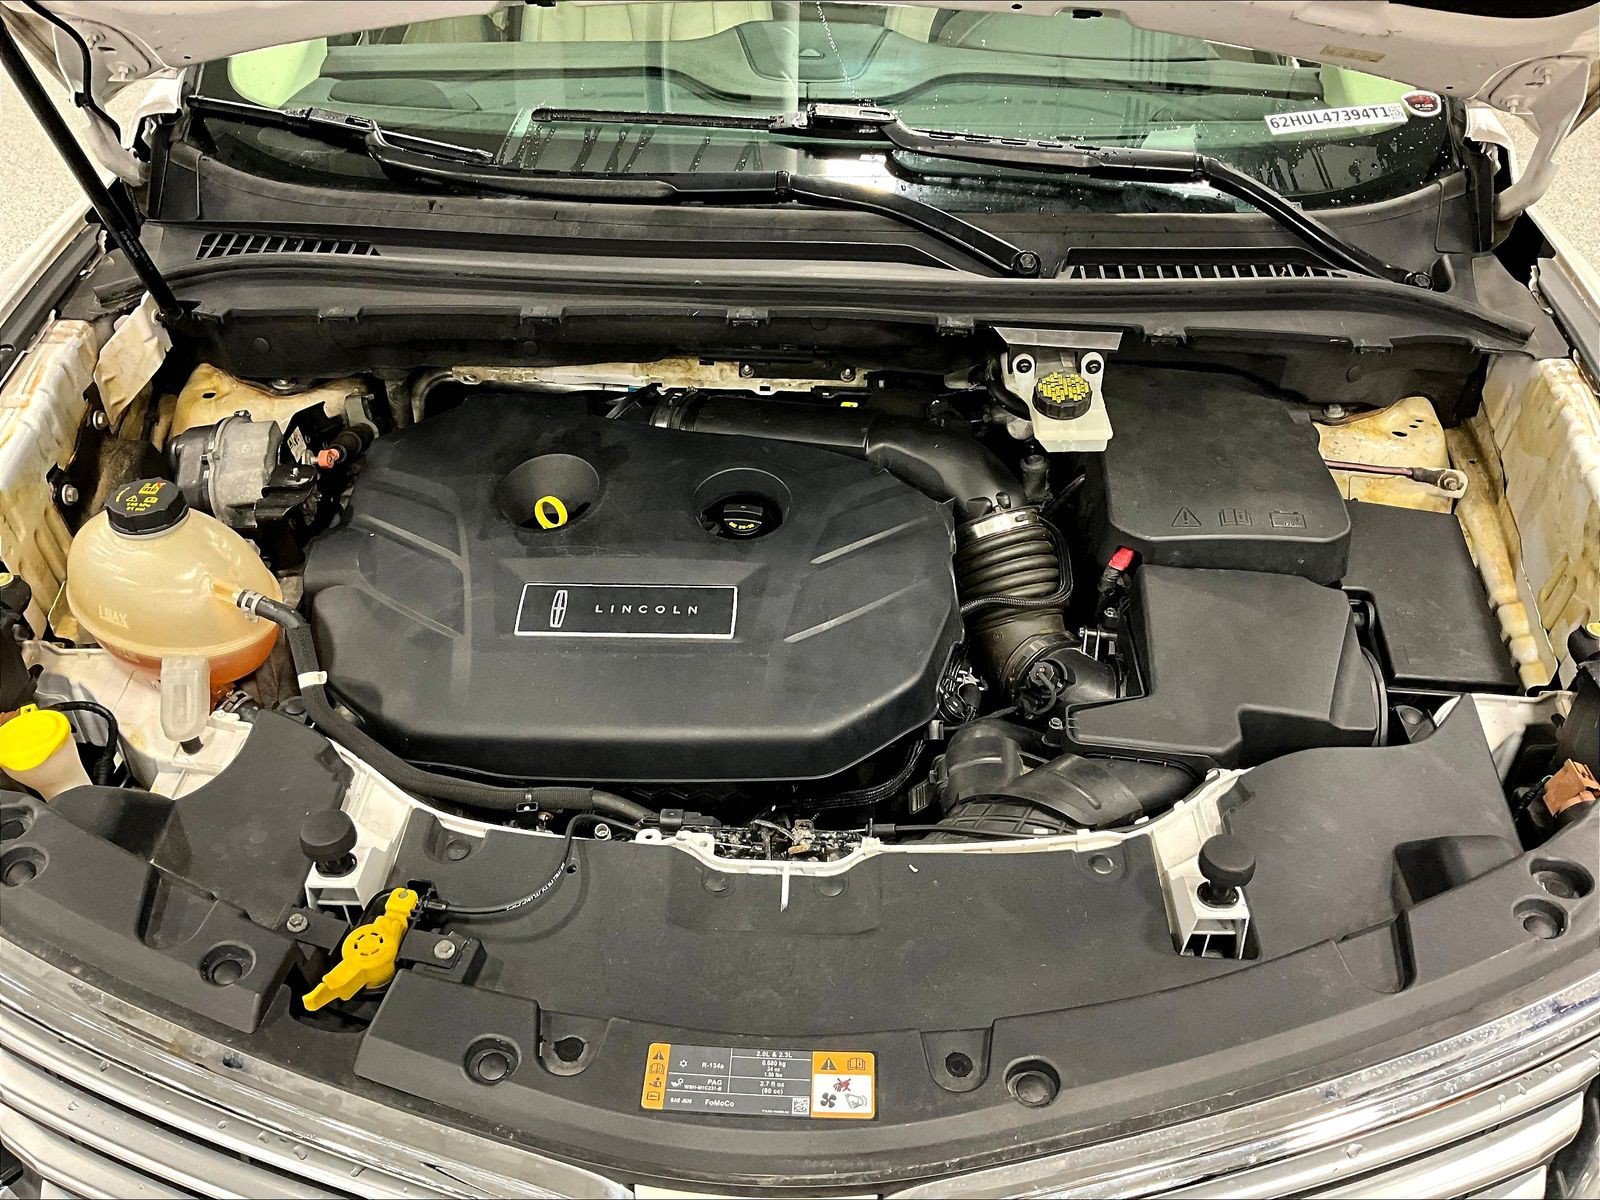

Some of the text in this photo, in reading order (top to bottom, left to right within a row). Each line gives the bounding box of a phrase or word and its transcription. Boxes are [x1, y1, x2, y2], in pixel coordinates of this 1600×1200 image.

[1270, 106, 1391, 129] 62HUL47394T1
[595, 604, 698, 615] LINCOLN
[705, 1099, 735, 1107] FoMoCo
